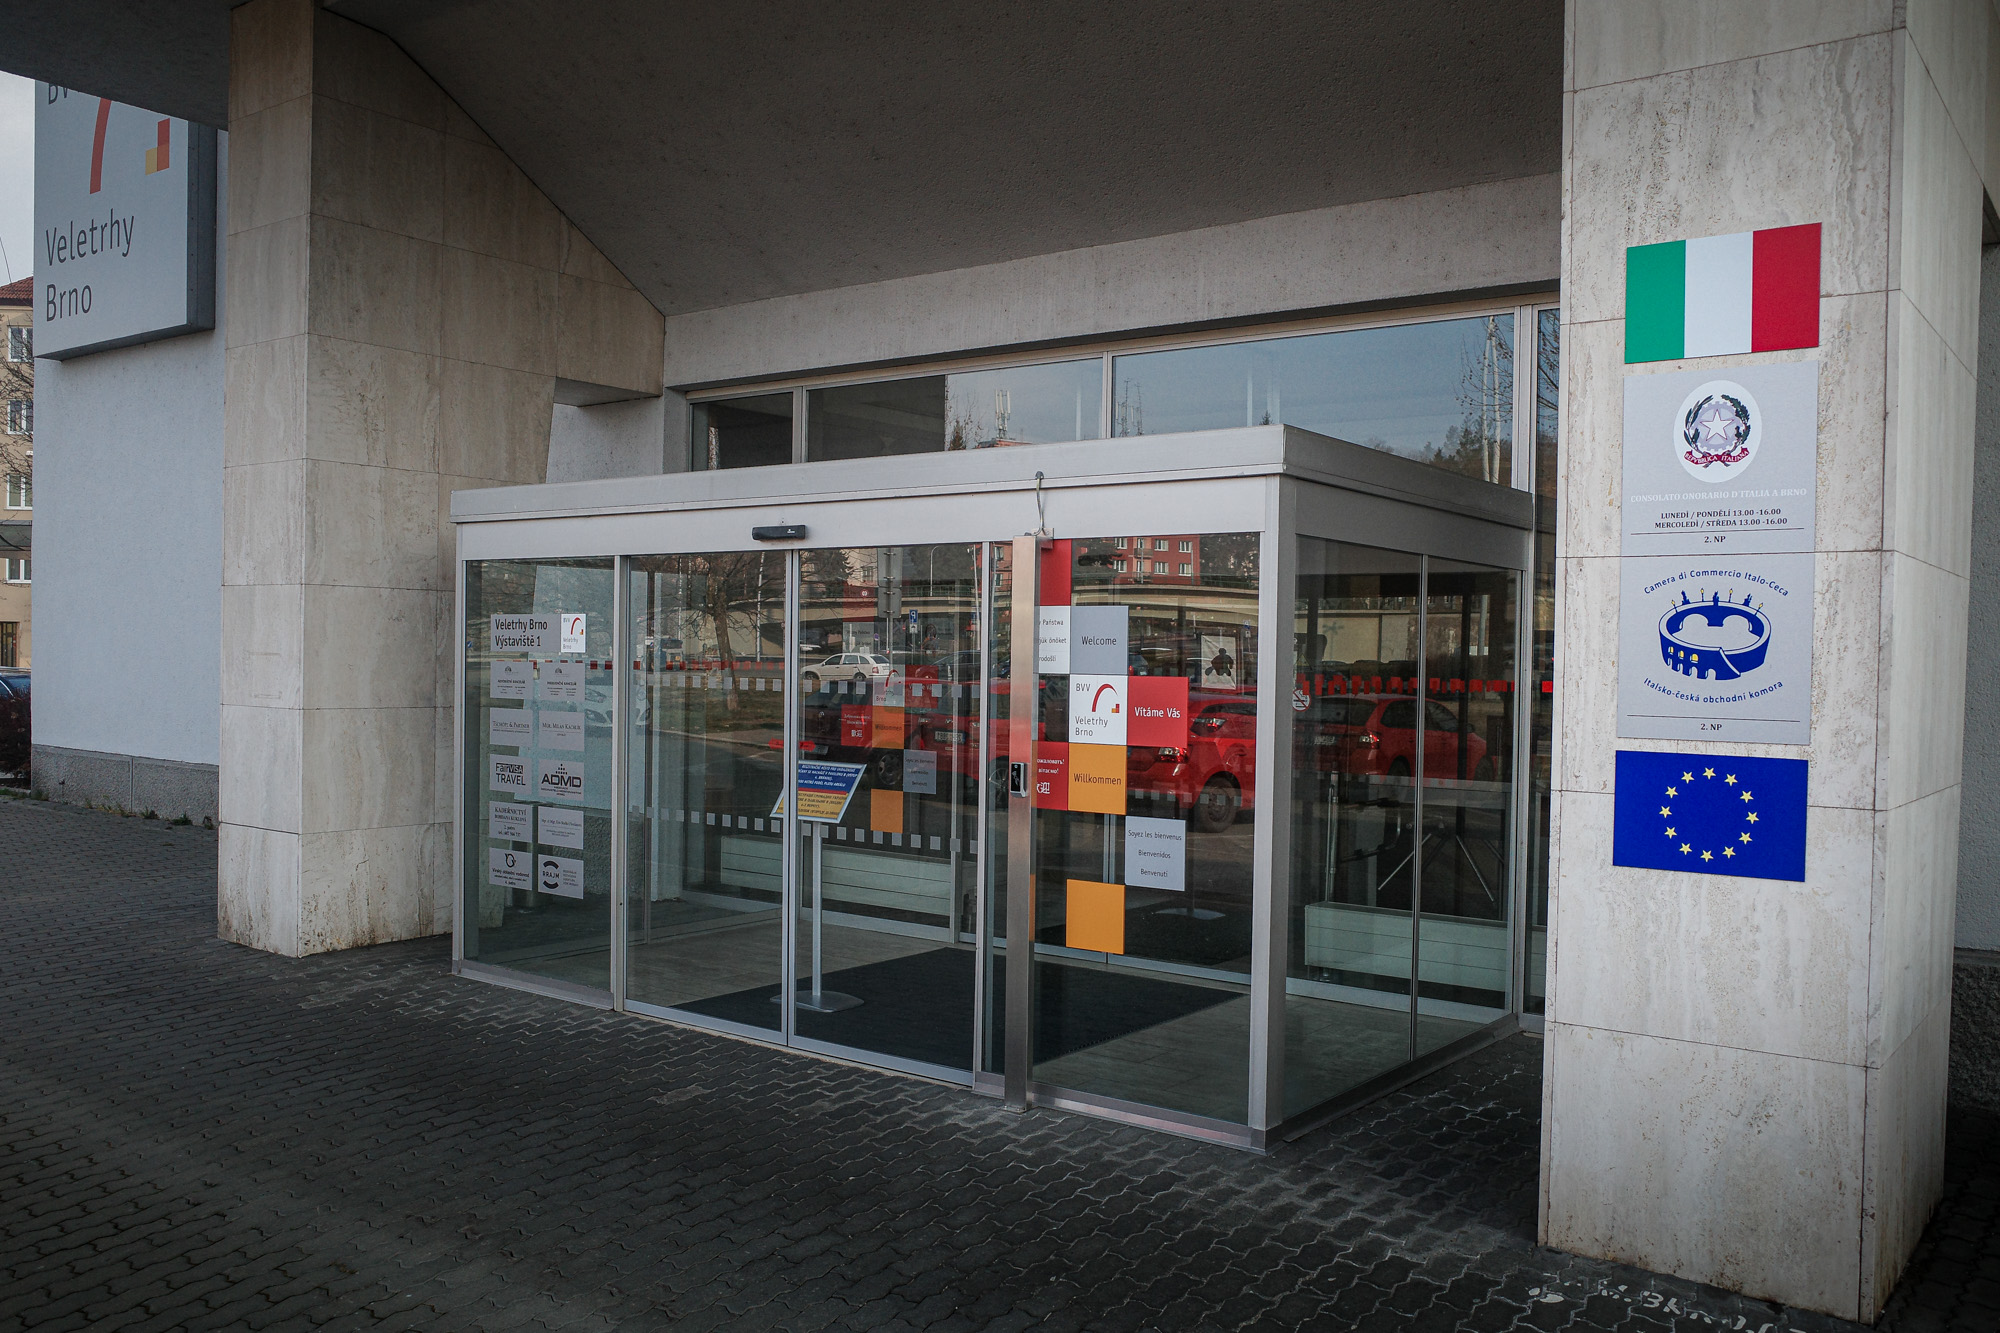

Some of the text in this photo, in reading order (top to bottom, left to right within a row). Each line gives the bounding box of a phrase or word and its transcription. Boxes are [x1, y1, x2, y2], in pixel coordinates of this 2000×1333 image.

[46, 208, 134, 267] Veletrhy
[46, 282, 92, 322] Brno
[1630, 493, 1681, 503] CONSOLATO
[1682, 491, 1729, 501] ONORARIO
[1771, 489, 1779, 498] A
[1780, 488, 1807, 497] BRNO
[1696, 508, 1731, 518] PONDĚLÍ
[1733, 509, 1754, 517] 13.00
[1705, 518, 1737, 528] STŘEDA
[1739, 519, 1760, 527] 13.00
[1704, 535, 1726, 544] 2. NP
[1644, 569, 1789, 597] Camera di Commercio Italo-Ceca
[494, 618, 548, 633] Veletrhy Brno
[494, 634, 541, 650] Výstaviště 1
[1081, 636, 1117, 646] Welcome
[1075, 682, 1091, 692] BVV
[1643, 677, 1784, 704] Italsko-česká obchodní komora
[1134, 707, 1181, 719] Vítáme Vás
[1075, 715, 1108, 728] Veletrhy
[1700, 723, 1723, 731] 2. NP
[1075, 727, 1094, 737] Brno
[495, 773, 526, 786] TRAVEL
[541, 773, 582, 788] ADMD
[1073, 773, 1122, 786] Willkommen
[1128, 829, 1182, 841] Soyez les bienvenus
[1138, 849, 1171, 859] Bienvenidos
[1140, 868, 1168, 878] Benvenuti
